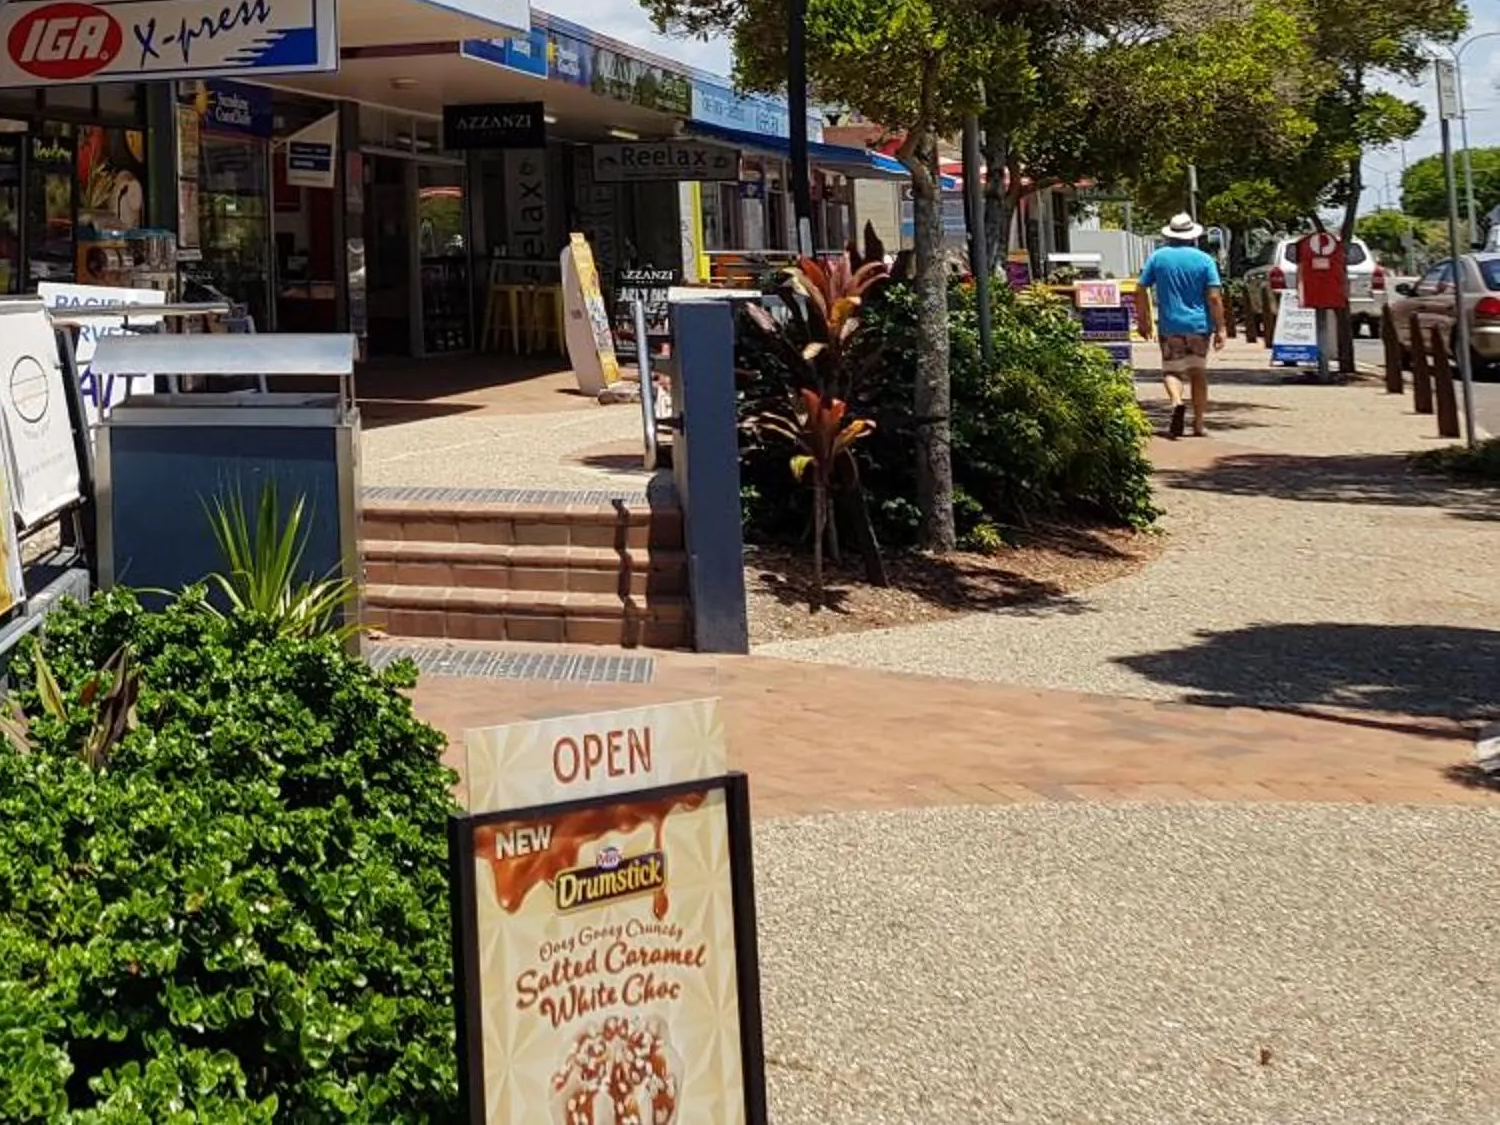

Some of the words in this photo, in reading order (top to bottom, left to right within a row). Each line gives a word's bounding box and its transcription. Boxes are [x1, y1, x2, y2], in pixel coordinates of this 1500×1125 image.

[22, 19, 109, 60] IGA
[457, 113, 532, 130] AZZANZI
[621, 146, 707, 167] Reelax
[552, 726, 653, 784] OPEN
[495, 825, 553, 860] NEW
[558, 852, 665, 907] Drumstick
[625, 918, 684, 942] Crunchy
[515, 948, 598, 1010] Salted
[604, 941, 706, 974] Caramel
[539, 985, 618, 1029] White
[621, 973, 682, 1008] Choc
